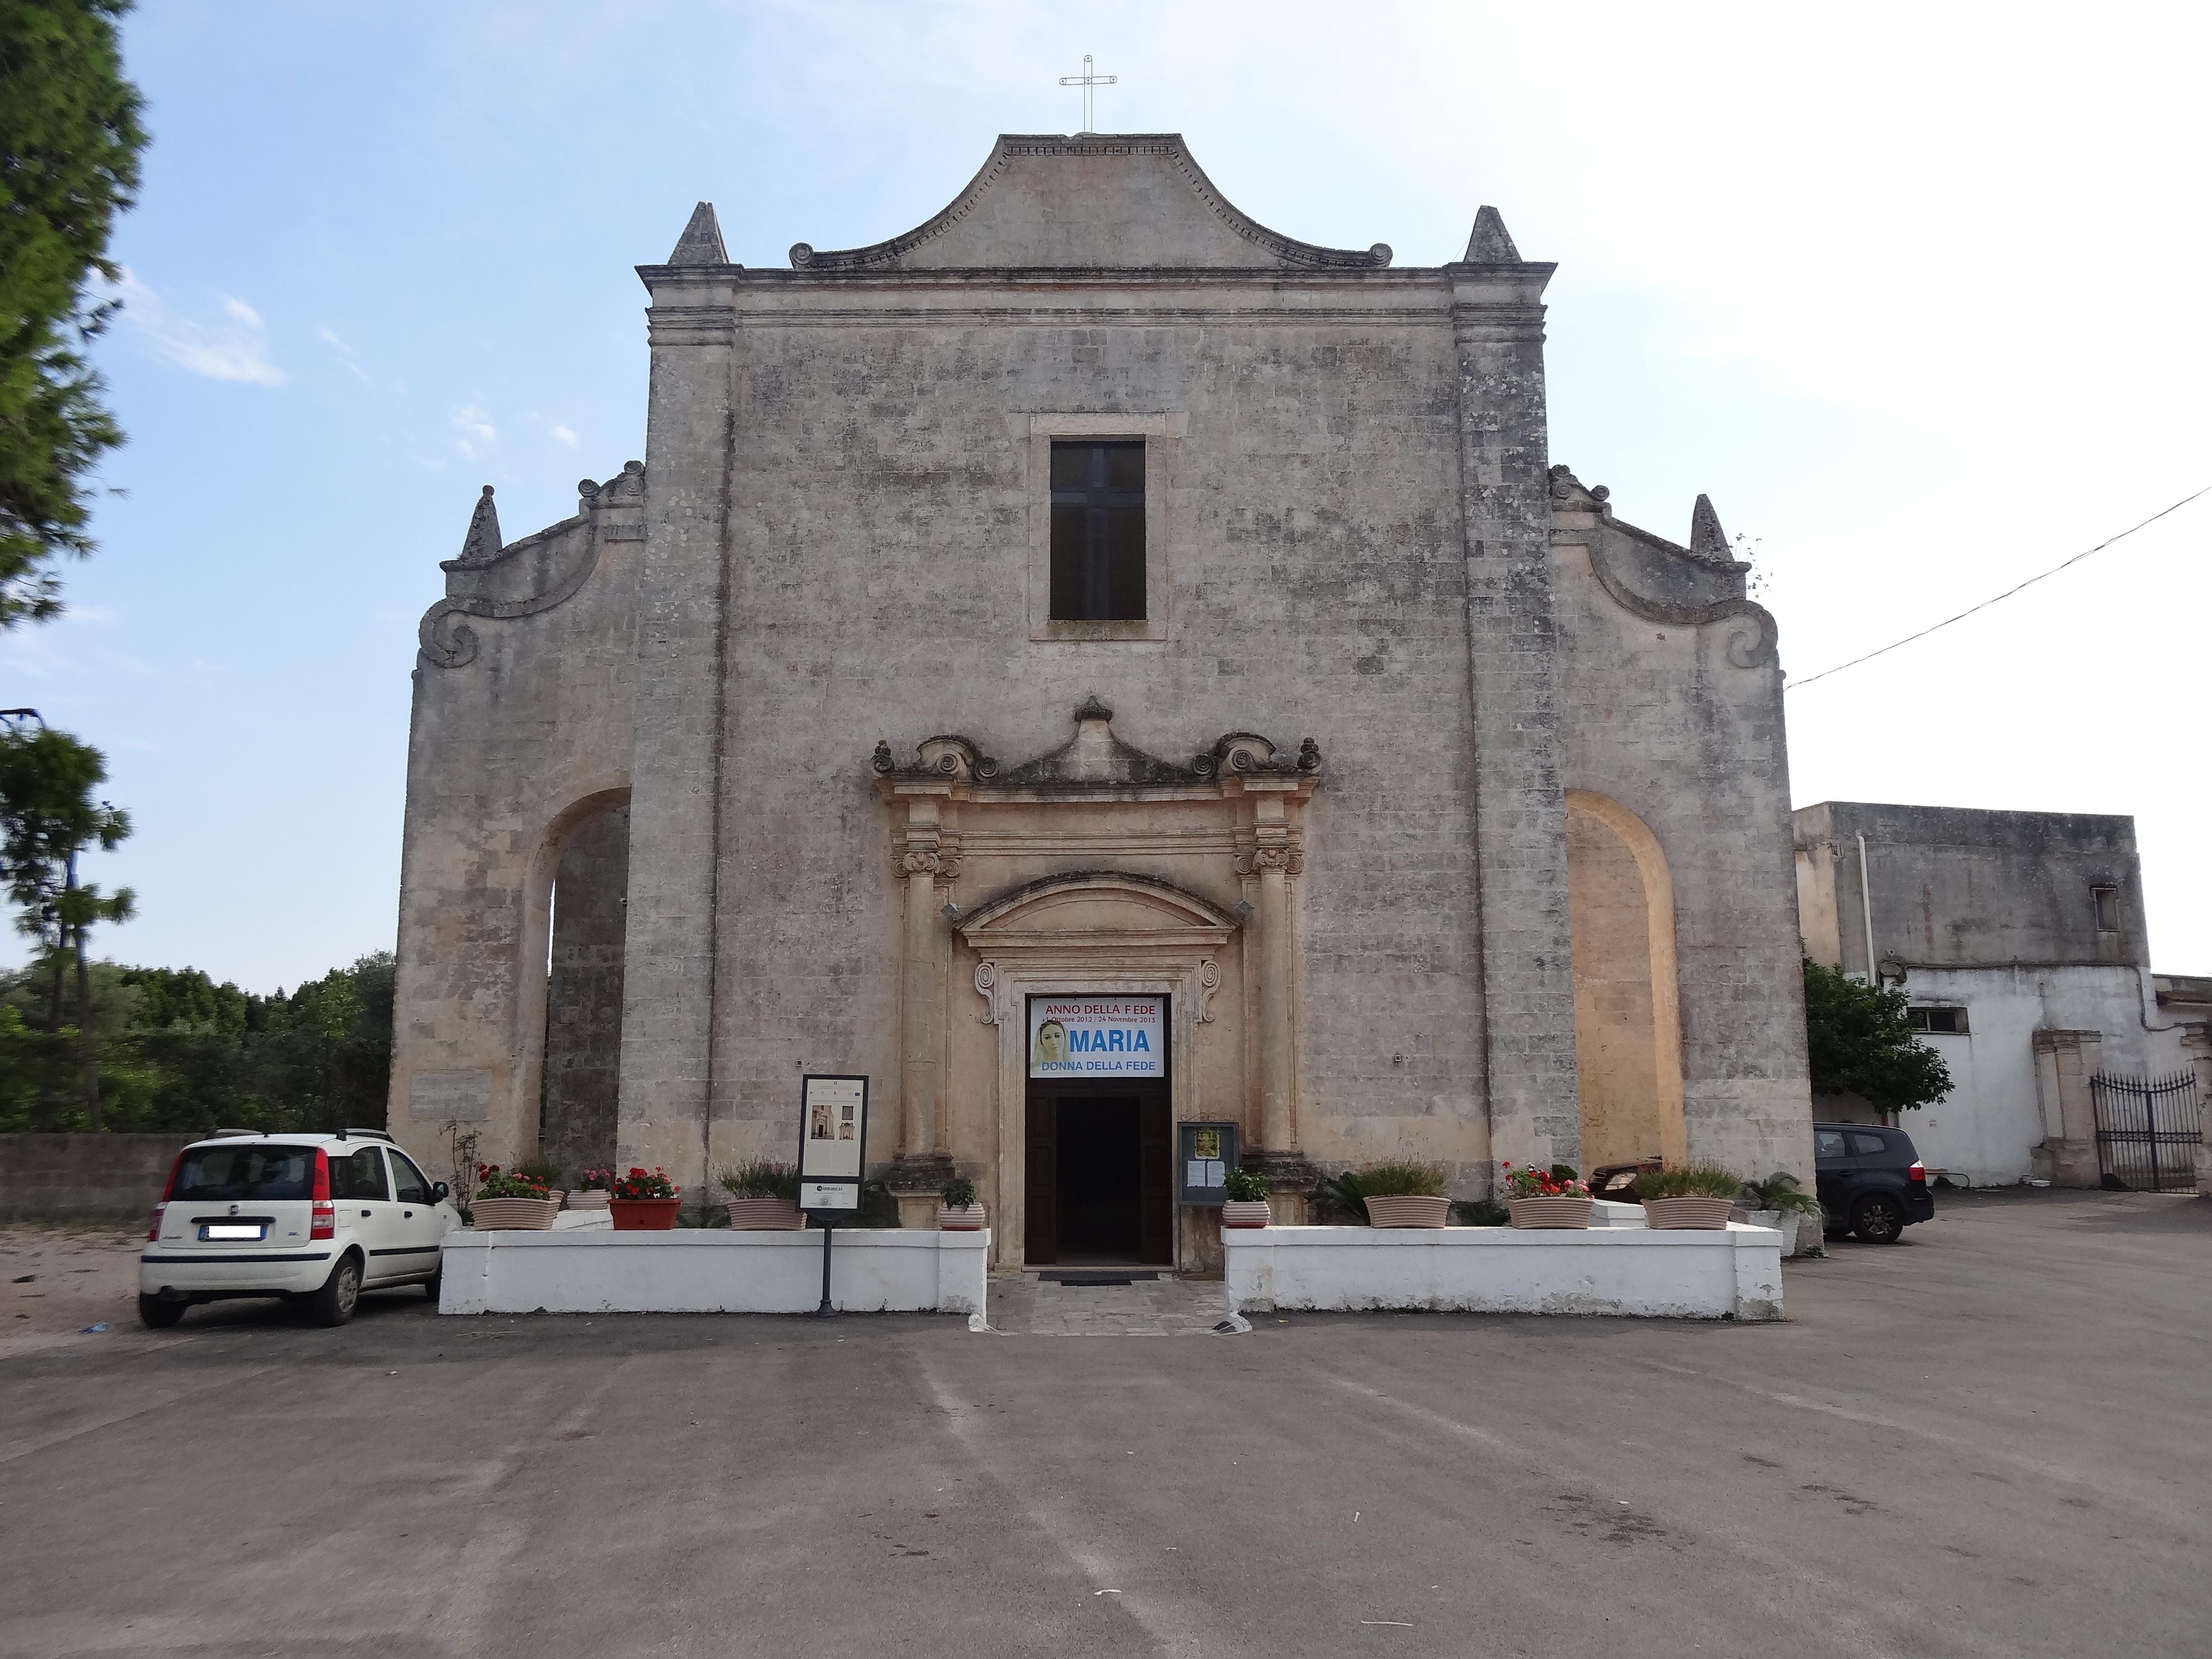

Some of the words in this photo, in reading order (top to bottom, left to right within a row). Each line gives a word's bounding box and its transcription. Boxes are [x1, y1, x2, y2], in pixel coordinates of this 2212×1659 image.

[1045, 1005, 1081, 1014] ANNO
[1084, 1005, 1120, 1014] DELLA
[1125, 1005, 1155, 1014] FEDE
[1070, 1030, 1150, 1052] MARIA
[1042, 1061, 1083, 1070] DONNA
[1087, 1061, 1122, 1070] DELLA
[1126, 1061, 1156, 1070] FEDE
